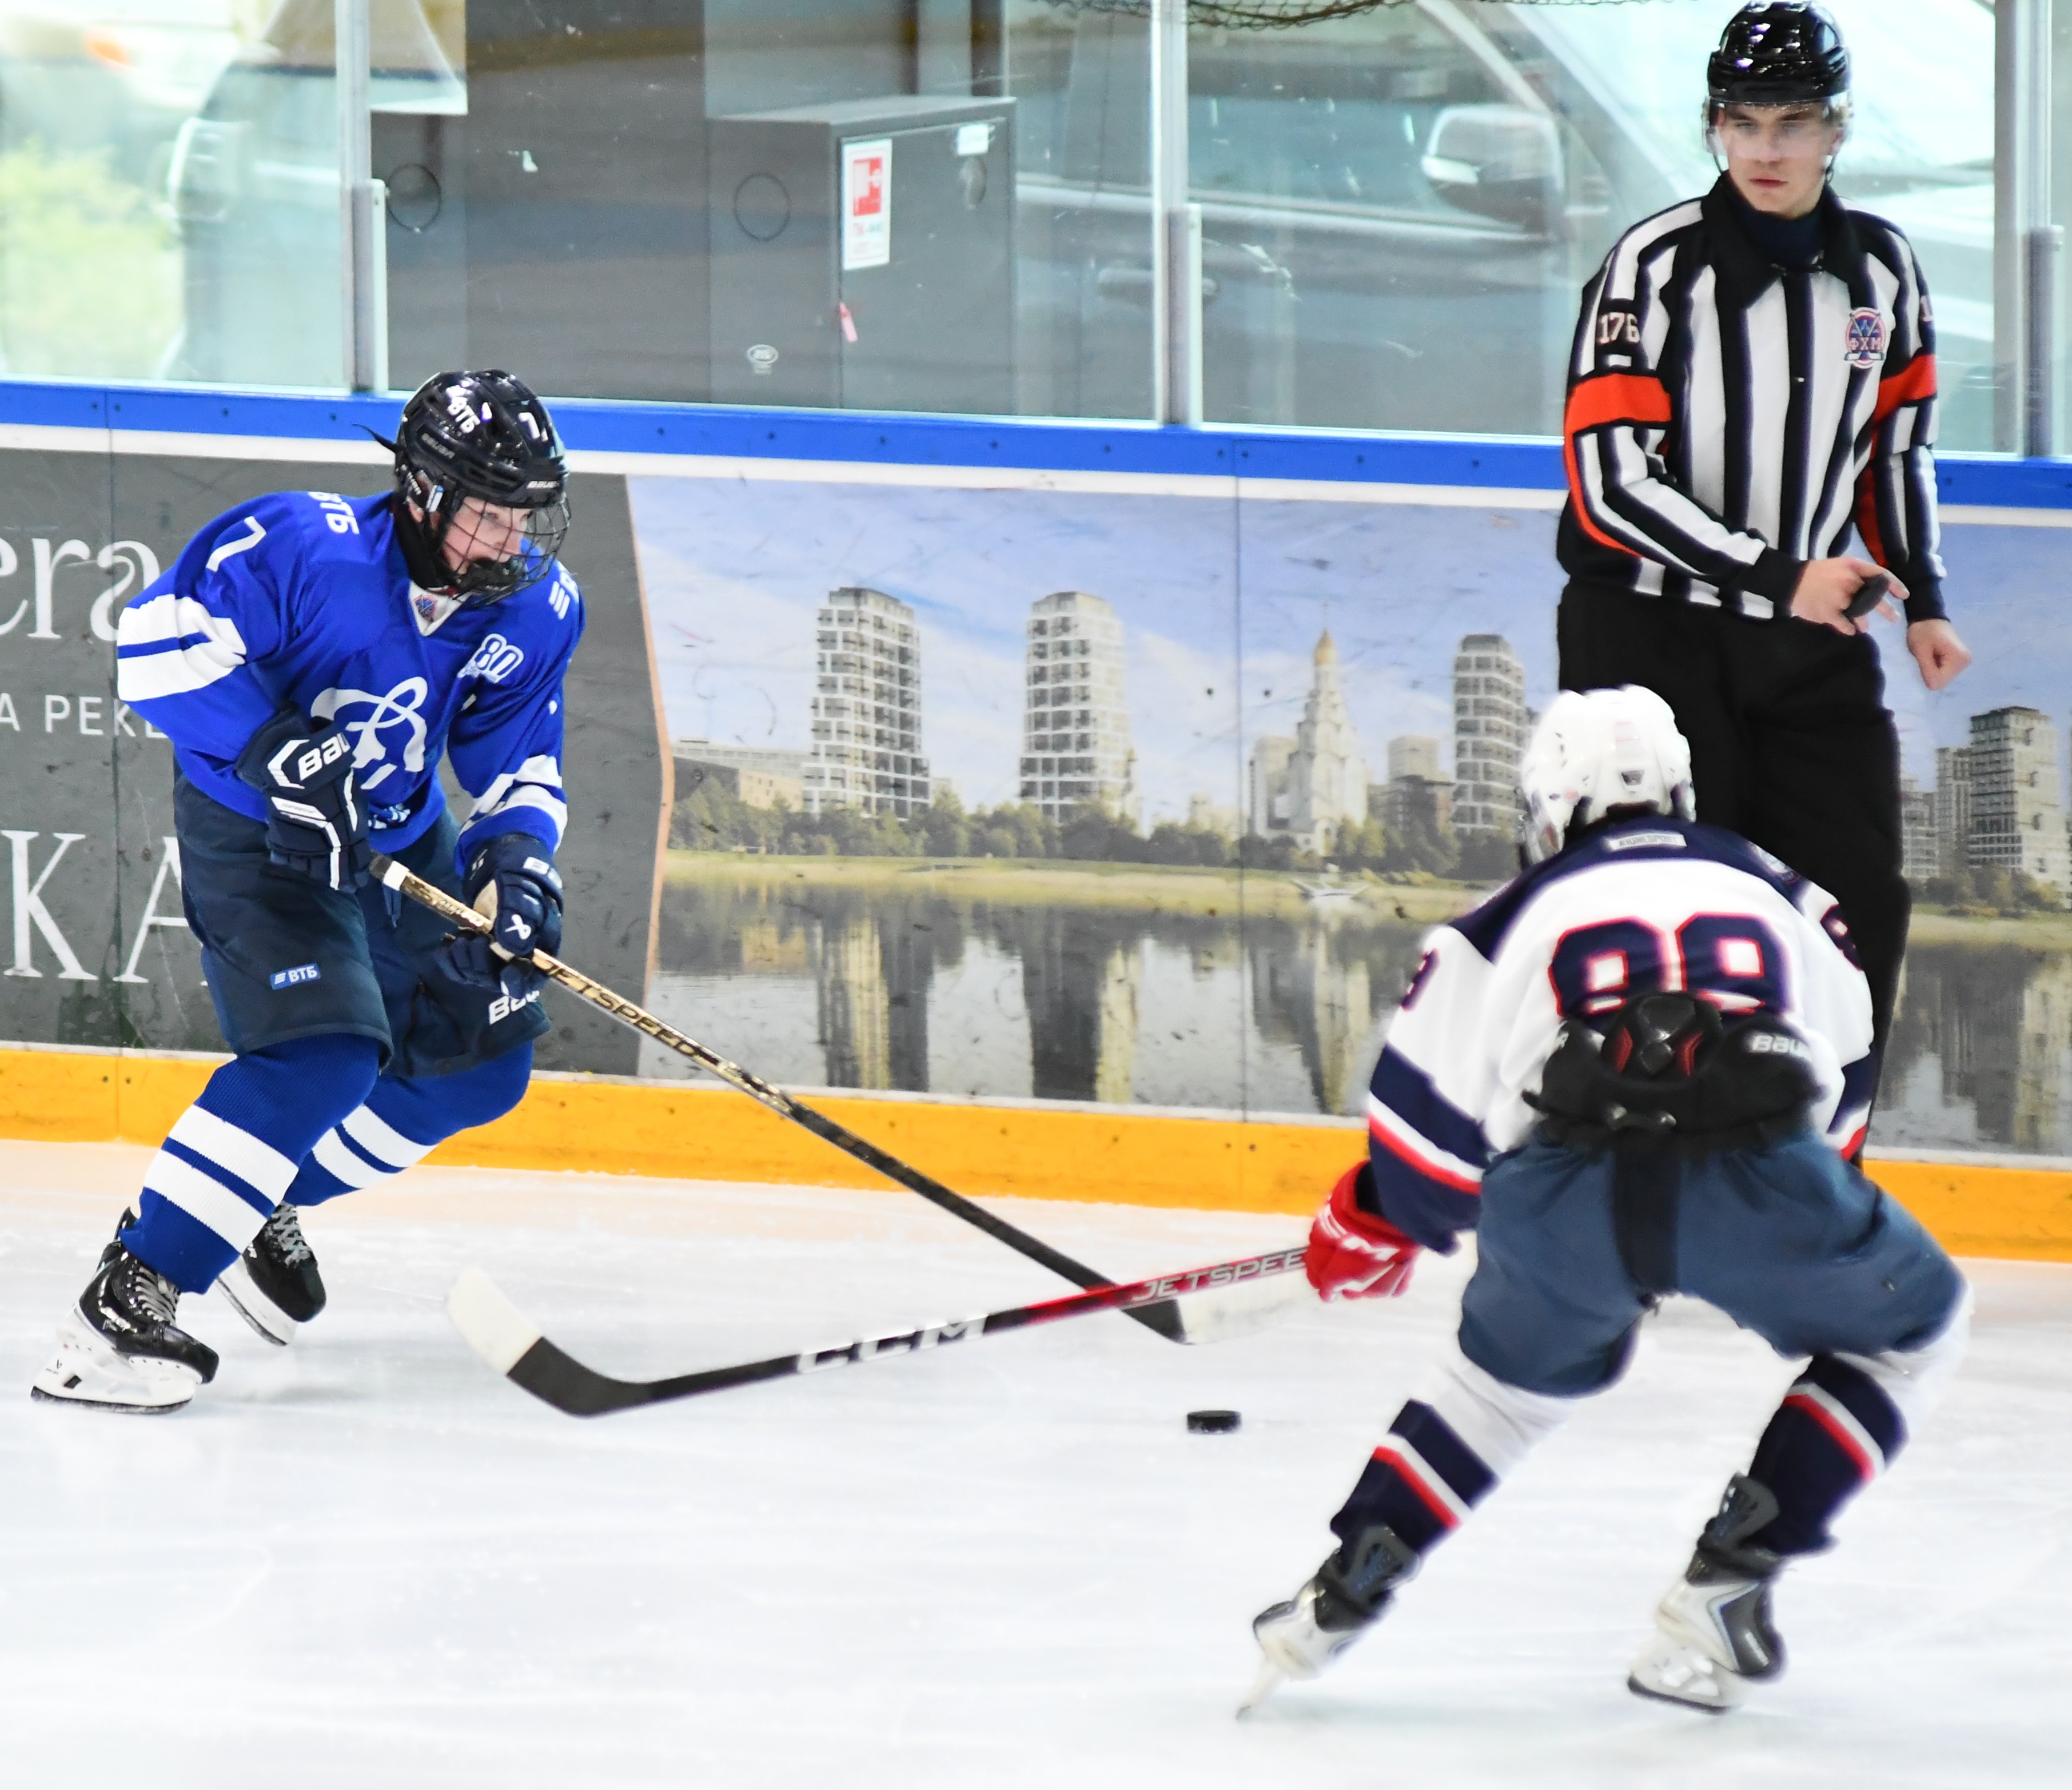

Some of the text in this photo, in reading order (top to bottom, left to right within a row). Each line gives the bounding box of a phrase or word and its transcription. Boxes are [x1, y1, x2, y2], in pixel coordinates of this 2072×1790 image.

[1599, 312, 1640, 344] 176
[206, 516, 266, 572] 7
[475, 633, 524, 679] 80
[45, 694, 172, 739] РЕК
[288, 966, 317, 983] ВТБ
[539, 962, 699, 1059] JETSPEED
[797, 1315, 988, 1374] CCM
